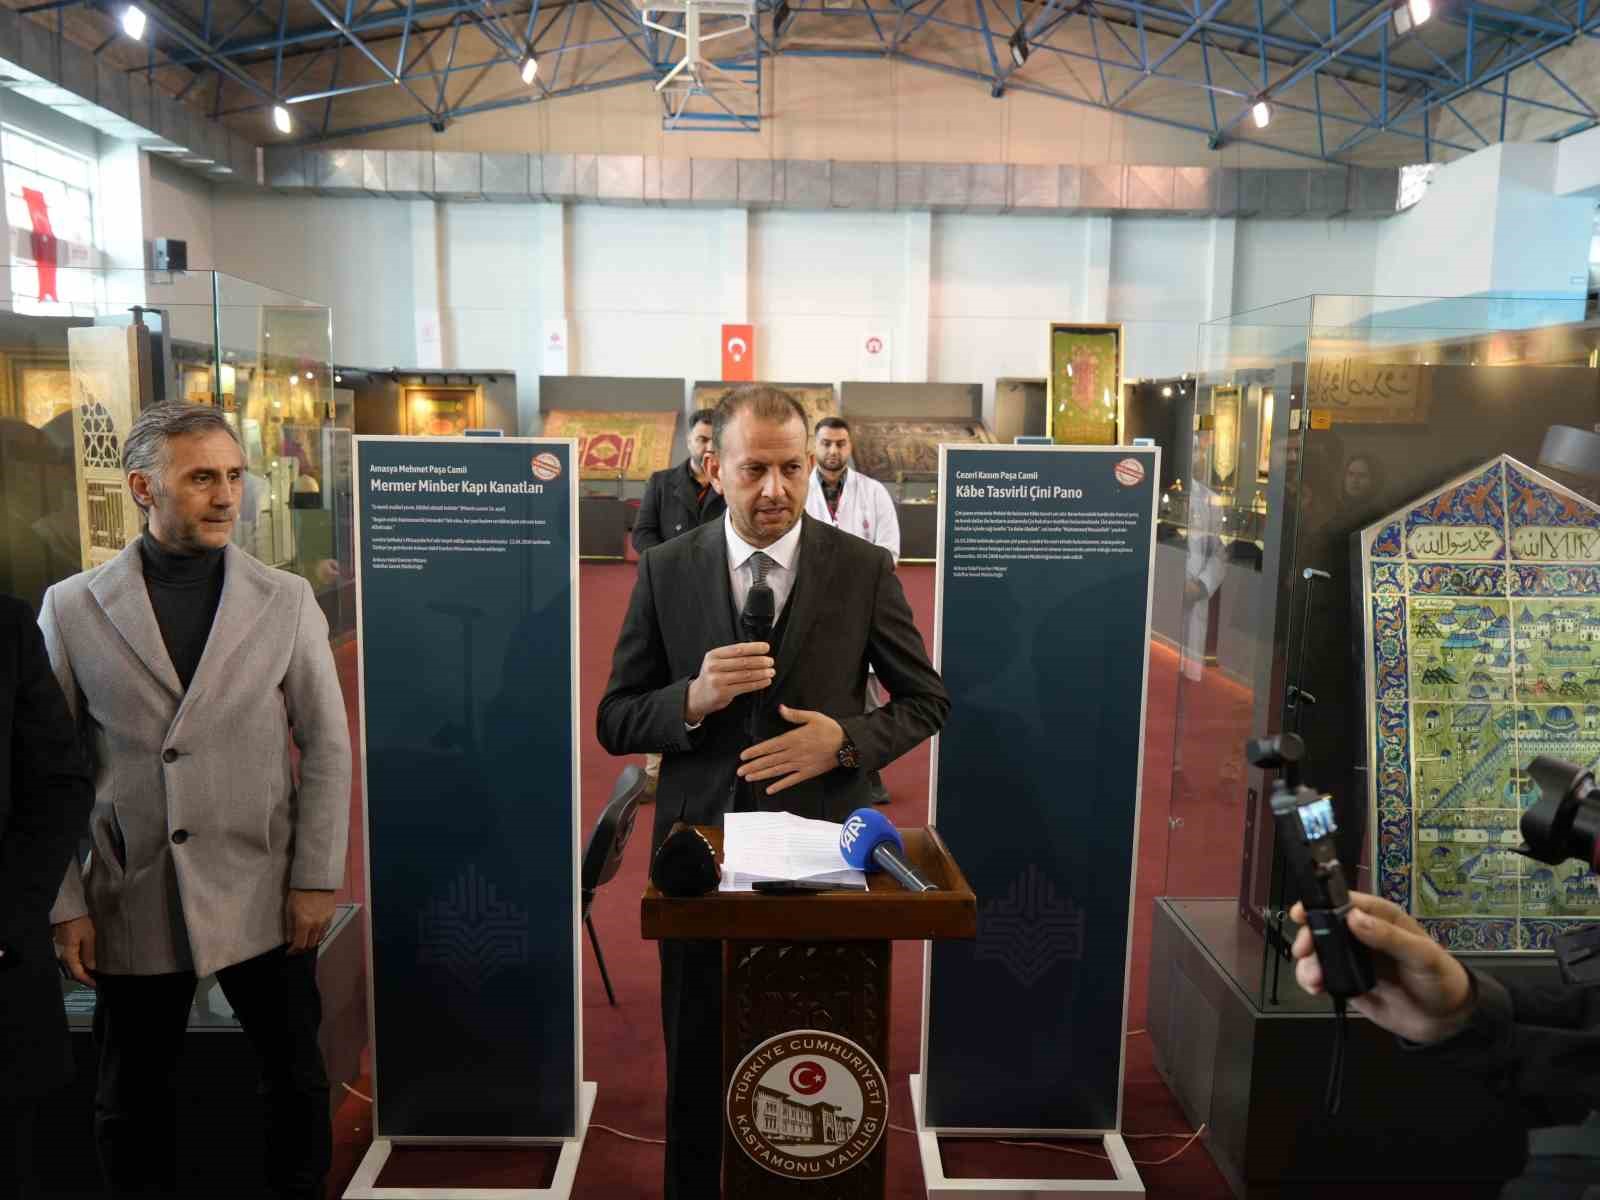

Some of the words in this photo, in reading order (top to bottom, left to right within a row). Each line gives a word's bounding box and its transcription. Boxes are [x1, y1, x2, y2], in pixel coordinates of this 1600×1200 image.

[370, 464, 398, 475] Amasya
[399, 465, 428, 474] Mehmet
[430, 465, 447, 476] Paşa
[1001, 471, 1017, 482] Paşa
[370, 479, 417, 492] Mermer
[418, 480, 460, 493] Minber
[461, 480, 487, 496] Kapı
[490, 480, 543, 494] Kanatları
[956, 485, 984, 498] Kâbe
[986, 485, 1028, 498] Tasvirli
[1030, 486, 1052, 501] Çini
[1053, 486, 1083, 499] Pano
[736, 1045, 786, 1102] TÜRKİYE
[737, 1114, 821, 1173] KASTAMONU
